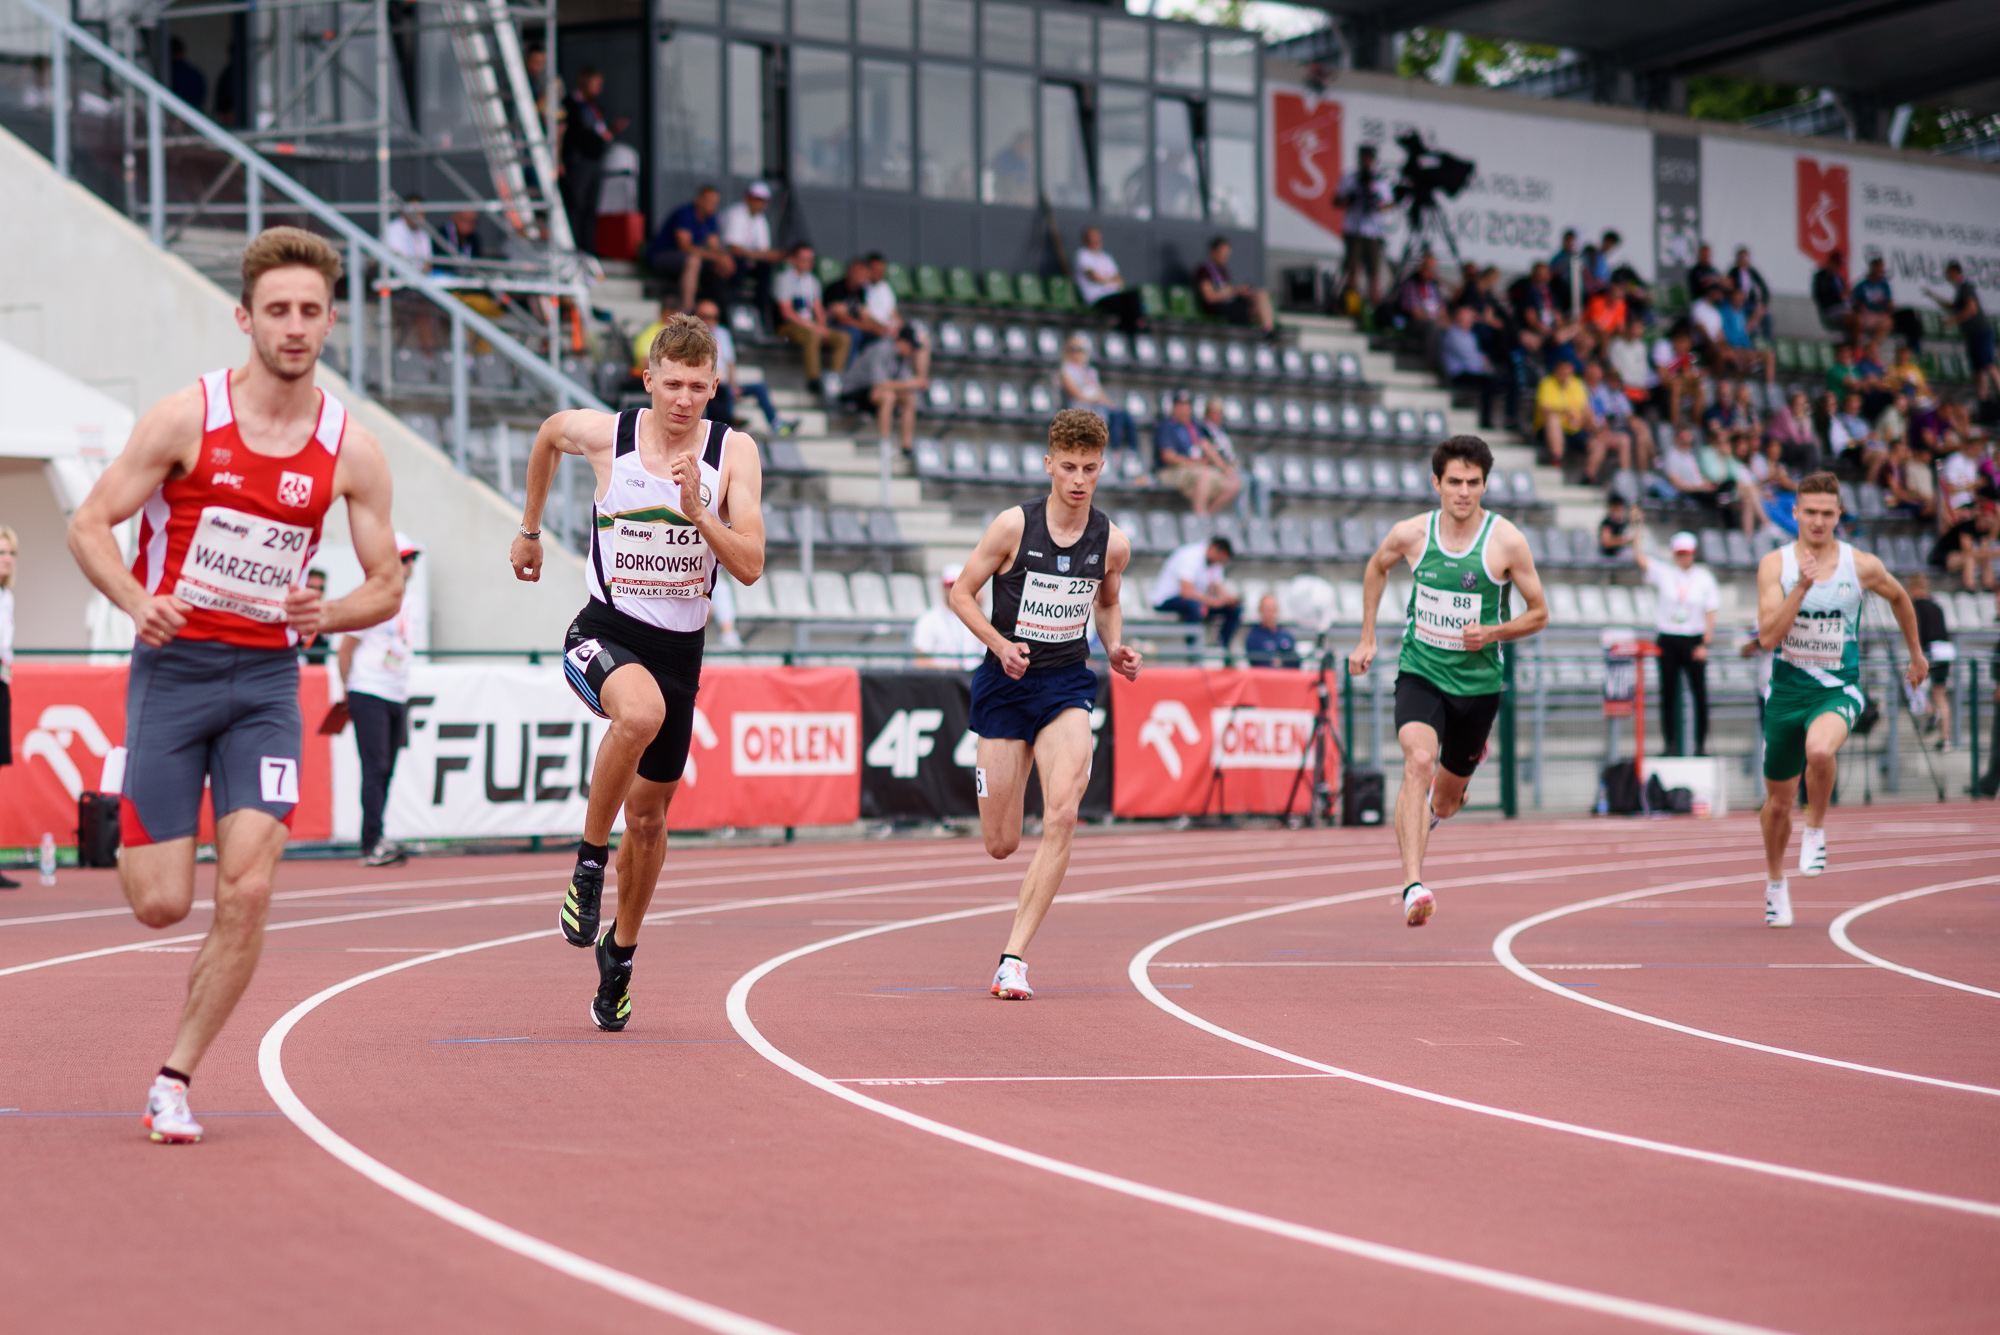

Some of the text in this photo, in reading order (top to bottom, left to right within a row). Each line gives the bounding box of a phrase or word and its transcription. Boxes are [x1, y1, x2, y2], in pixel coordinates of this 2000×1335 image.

[1486, 210, 1551, 249] 2022
[262, 527, 305, 552] 290
[665, 528, 702, 546] 161
[195, 544, 293, 588] WARZECHA
[615, 552, 703, 573] BORKOWSKI
[616, 585, 690, 597] SUWAŁKI 2022
[1067, 580, 1095, 594] 225
[240, 603, 271, 620] 2022
[1023, 599, 1089, 619] MAKOWSKI
[1453, 595, 1471, 609] 88
[1020, 628, 1075, 640] SUWAŁKI 2022
[1819, 621, 1840, 633] 173
[1783, 635, 1841, 652] ADAMCZEWSKI
[743, 725, 846, 763] ORLEN
[866, 709, 944, 778] 4F
[1222, 722, 1307, 754] ORLEN
[269, 763, 287, 796] 7
